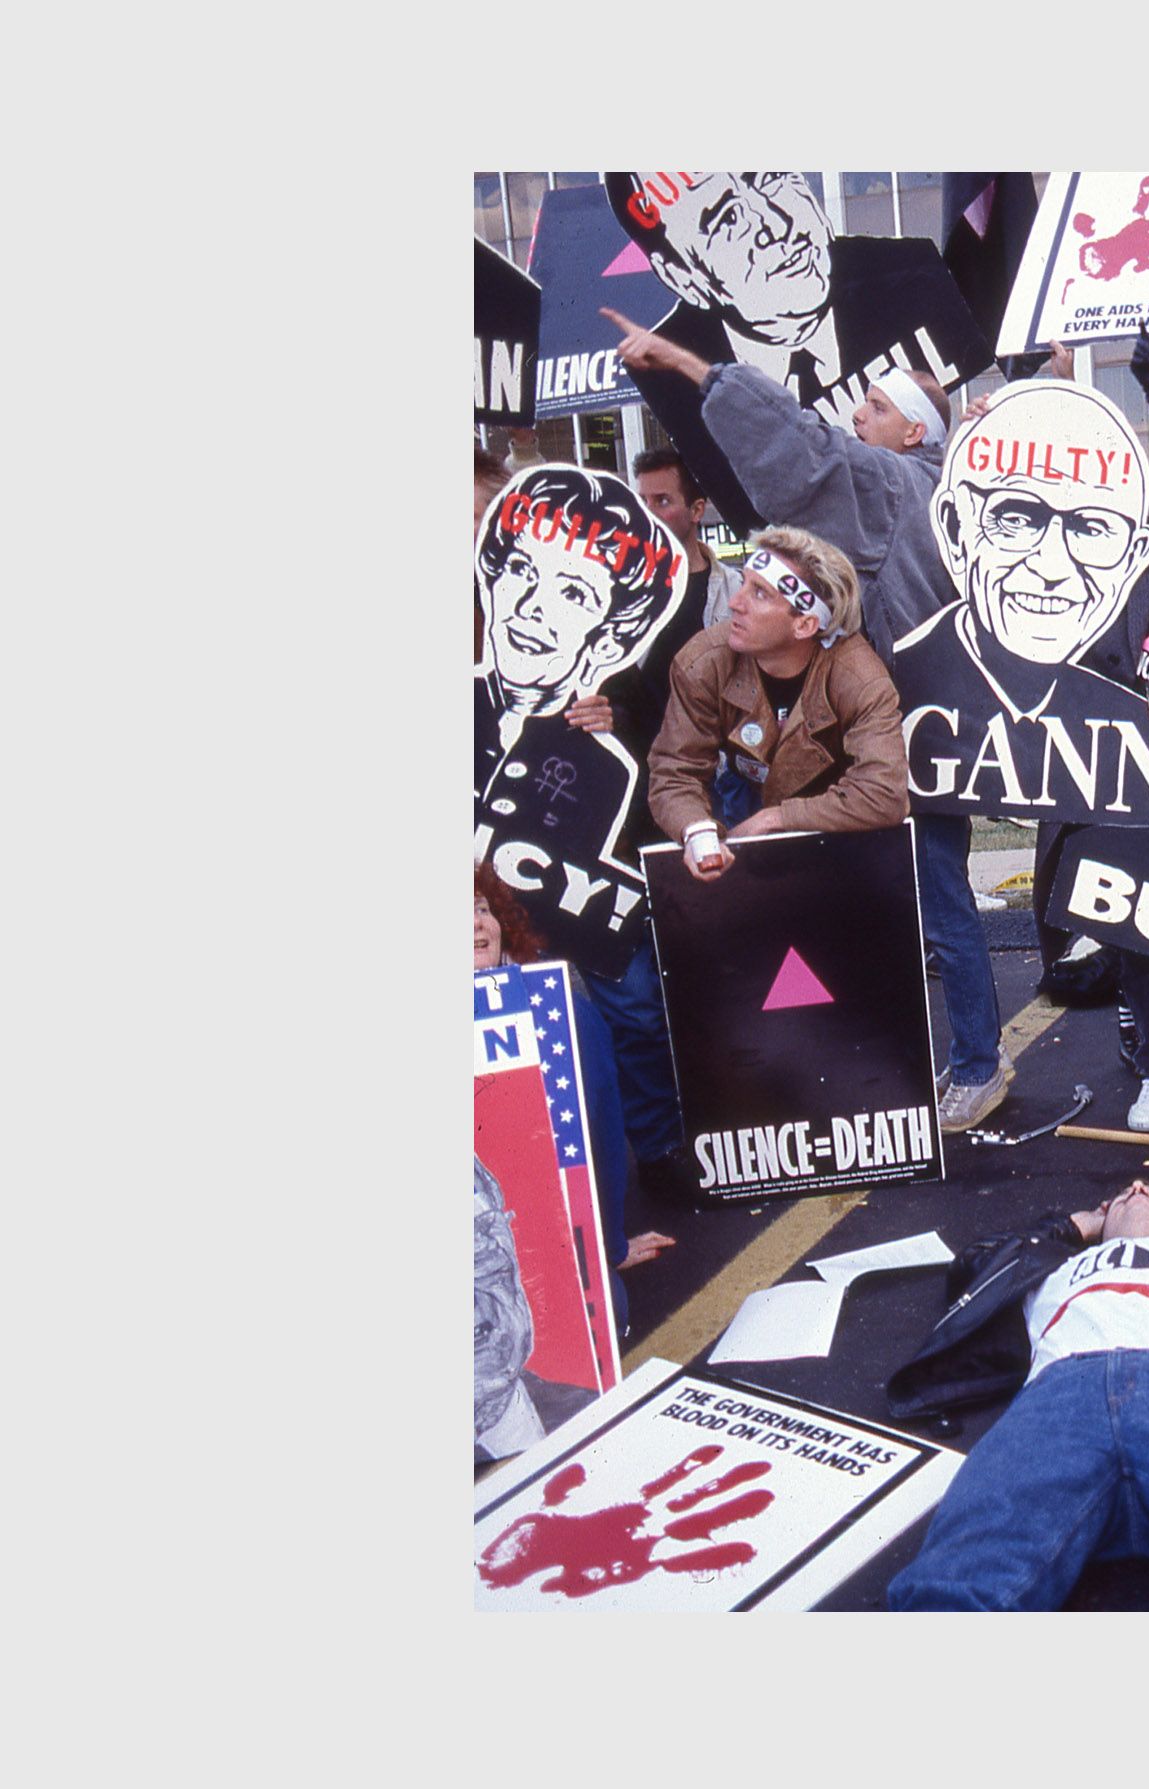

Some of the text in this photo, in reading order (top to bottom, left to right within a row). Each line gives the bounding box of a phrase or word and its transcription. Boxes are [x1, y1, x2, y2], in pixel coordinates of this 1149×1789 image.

[1063, 318, 1111, 333] EVERY
[1074, 306, 1105, 319] ONE
[1107, 303, 1143, 316] AIDS
[967, 436, 1131, 485] GUILTY!
[499, 492, 683, 588] GUILTY!
[694, 1106, 933, 1189] SILENCE=DEATH
[1070, 1239, 1136, 1287] ACT
[660, 1403, 872, 1477] BLOOD ON ITS HANDS
[676, 1387, 898, 1465] THE GOVERNMENT HAS
